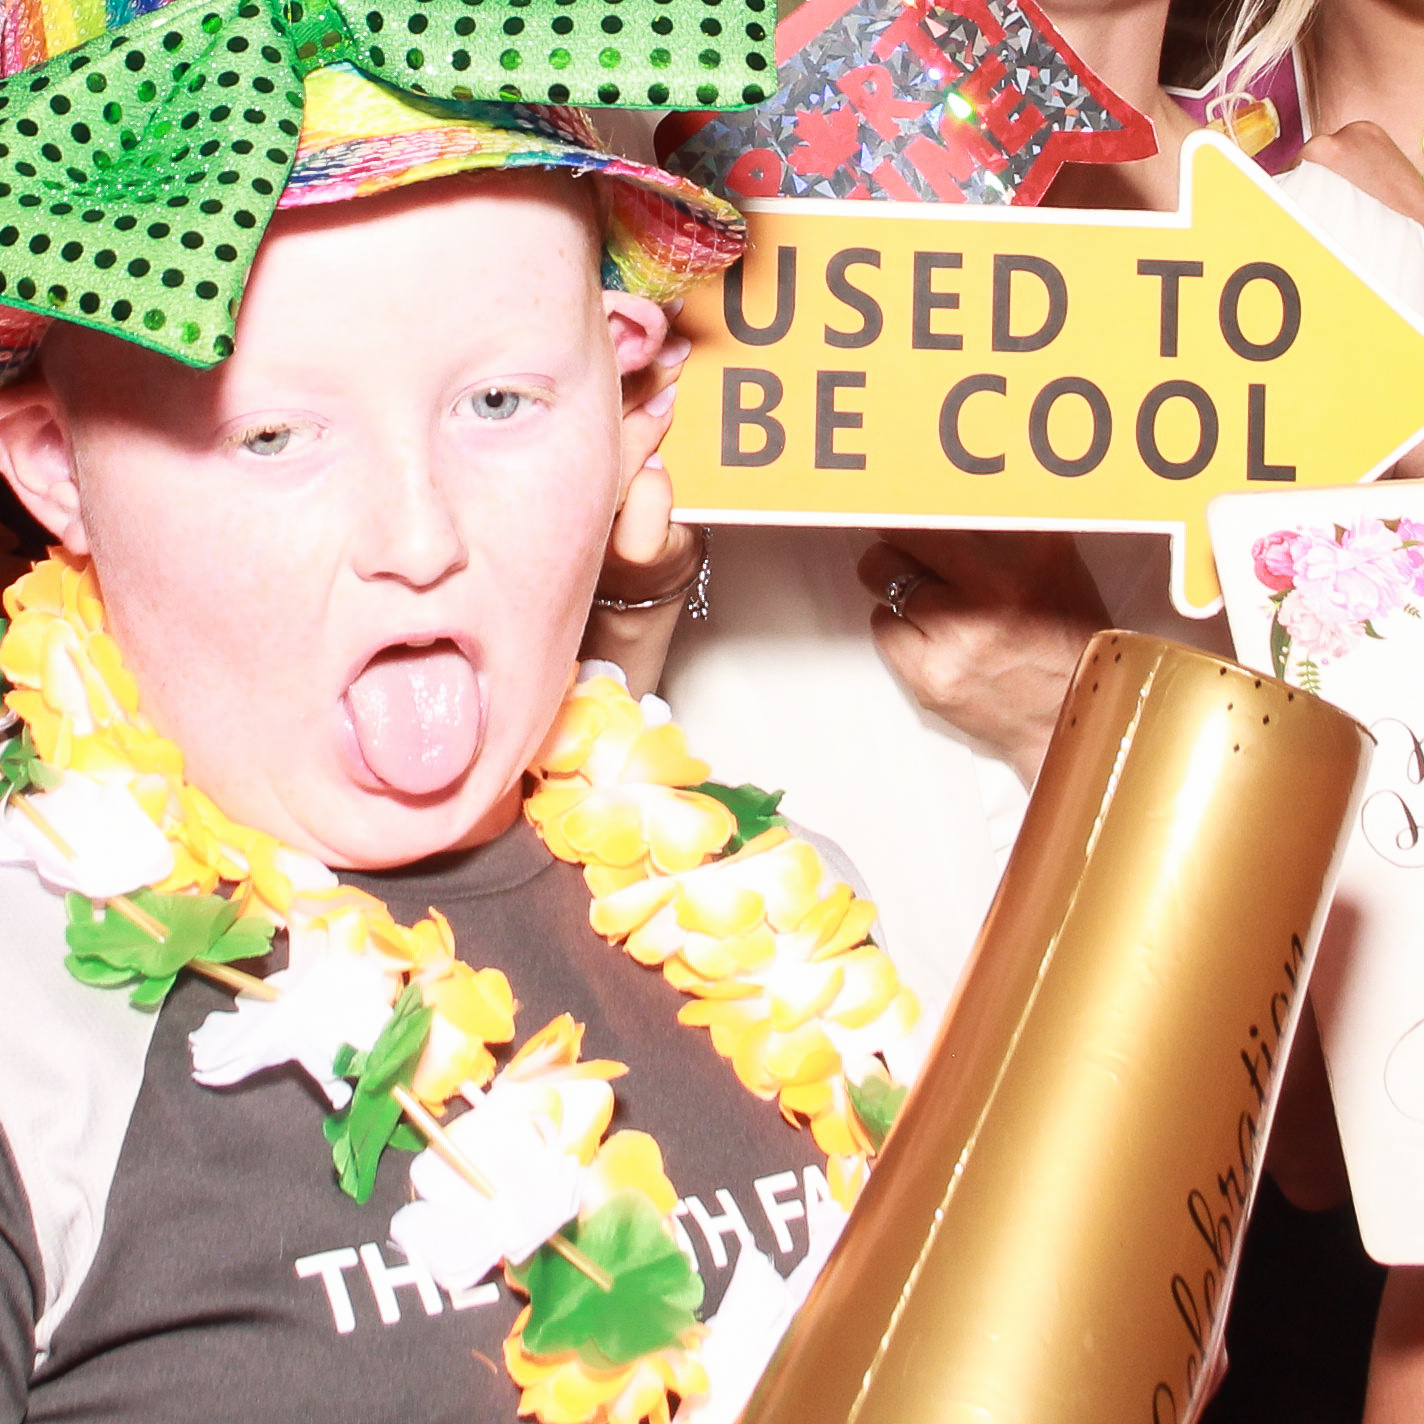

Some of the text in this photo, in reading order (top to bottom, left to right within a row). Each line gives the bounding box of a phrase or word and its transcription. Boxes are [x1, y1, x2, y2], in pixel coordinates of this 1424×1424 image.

[722, 246, 1303, 363] USED TO
[720, 367, 1296, 483] BE COOL
[295, 1242, 499, 1333] TH
